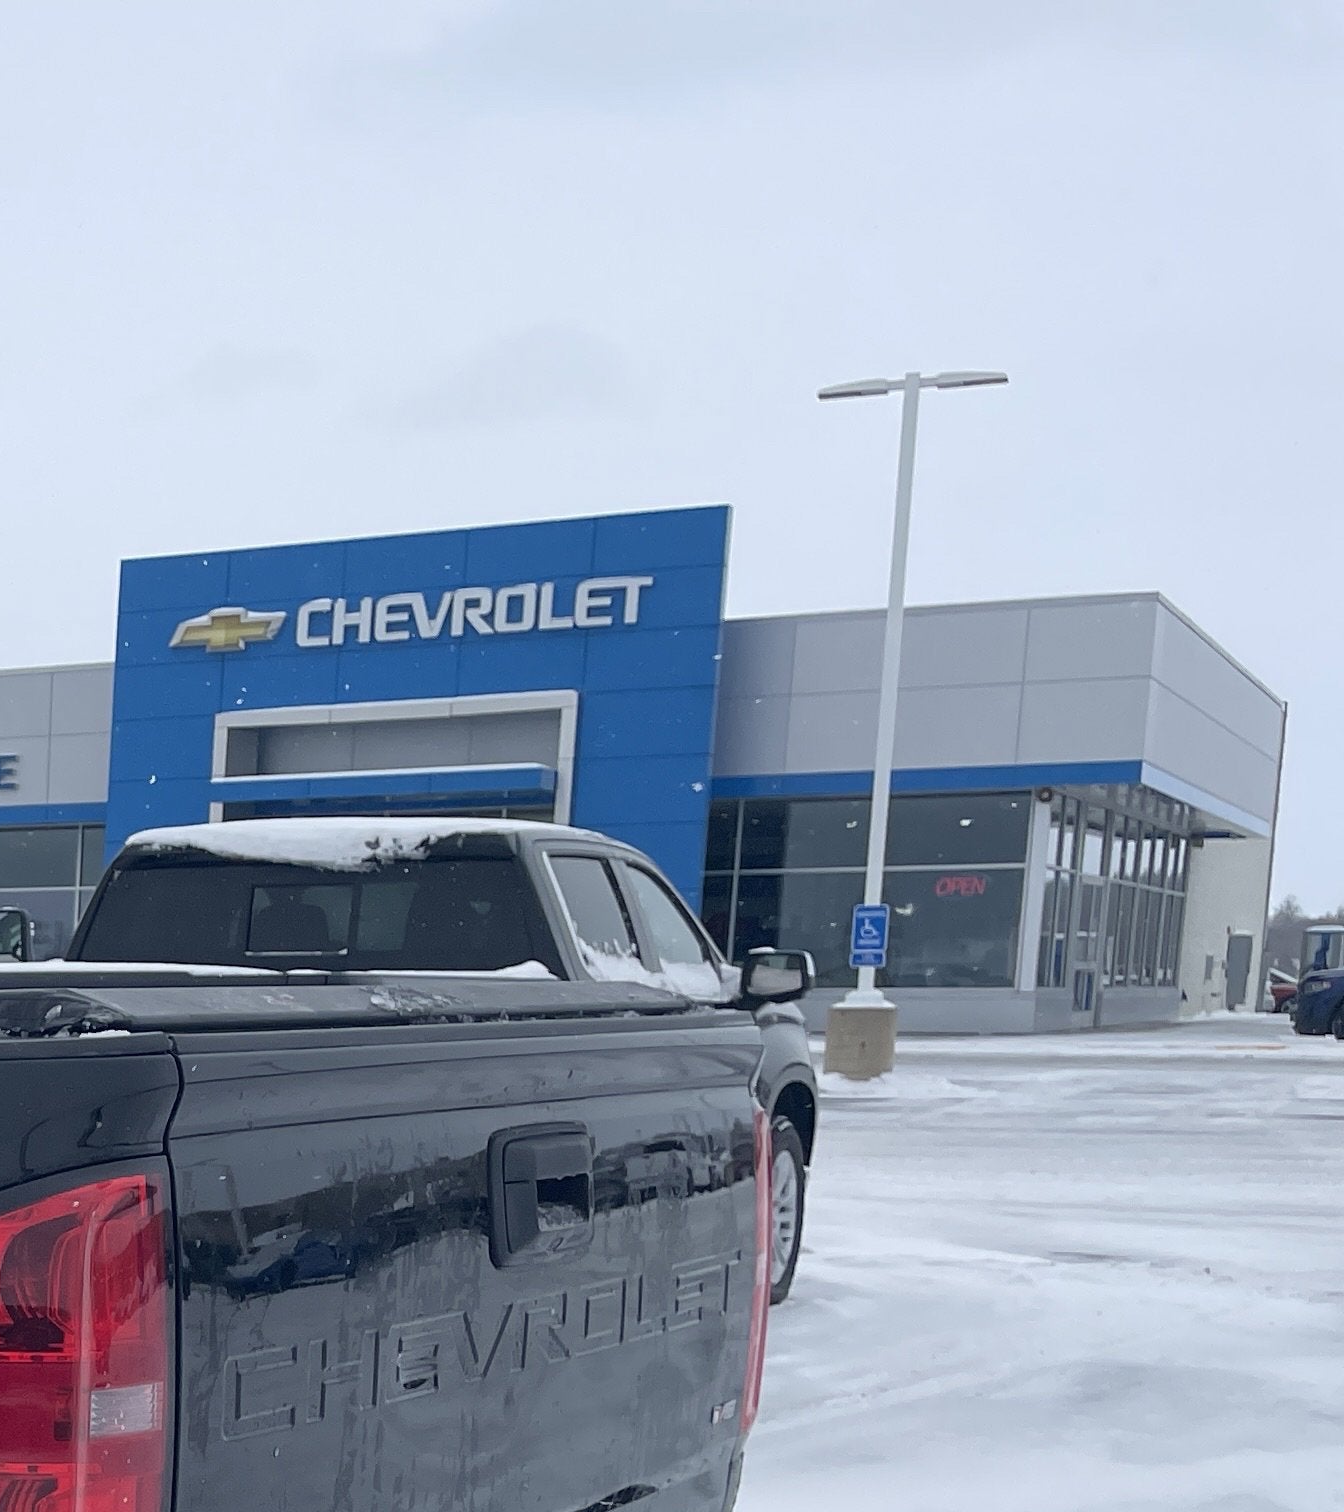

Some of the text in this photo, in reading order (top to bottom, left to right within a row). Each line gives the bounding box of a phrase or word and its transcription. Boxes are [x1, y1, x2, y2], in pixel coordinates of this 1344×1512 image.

[295, 575, 654, 648] CHEVROLET
[934, 876, 985, 897] OPEN
[222, 1249, 741, 1441] CHEVROLET
